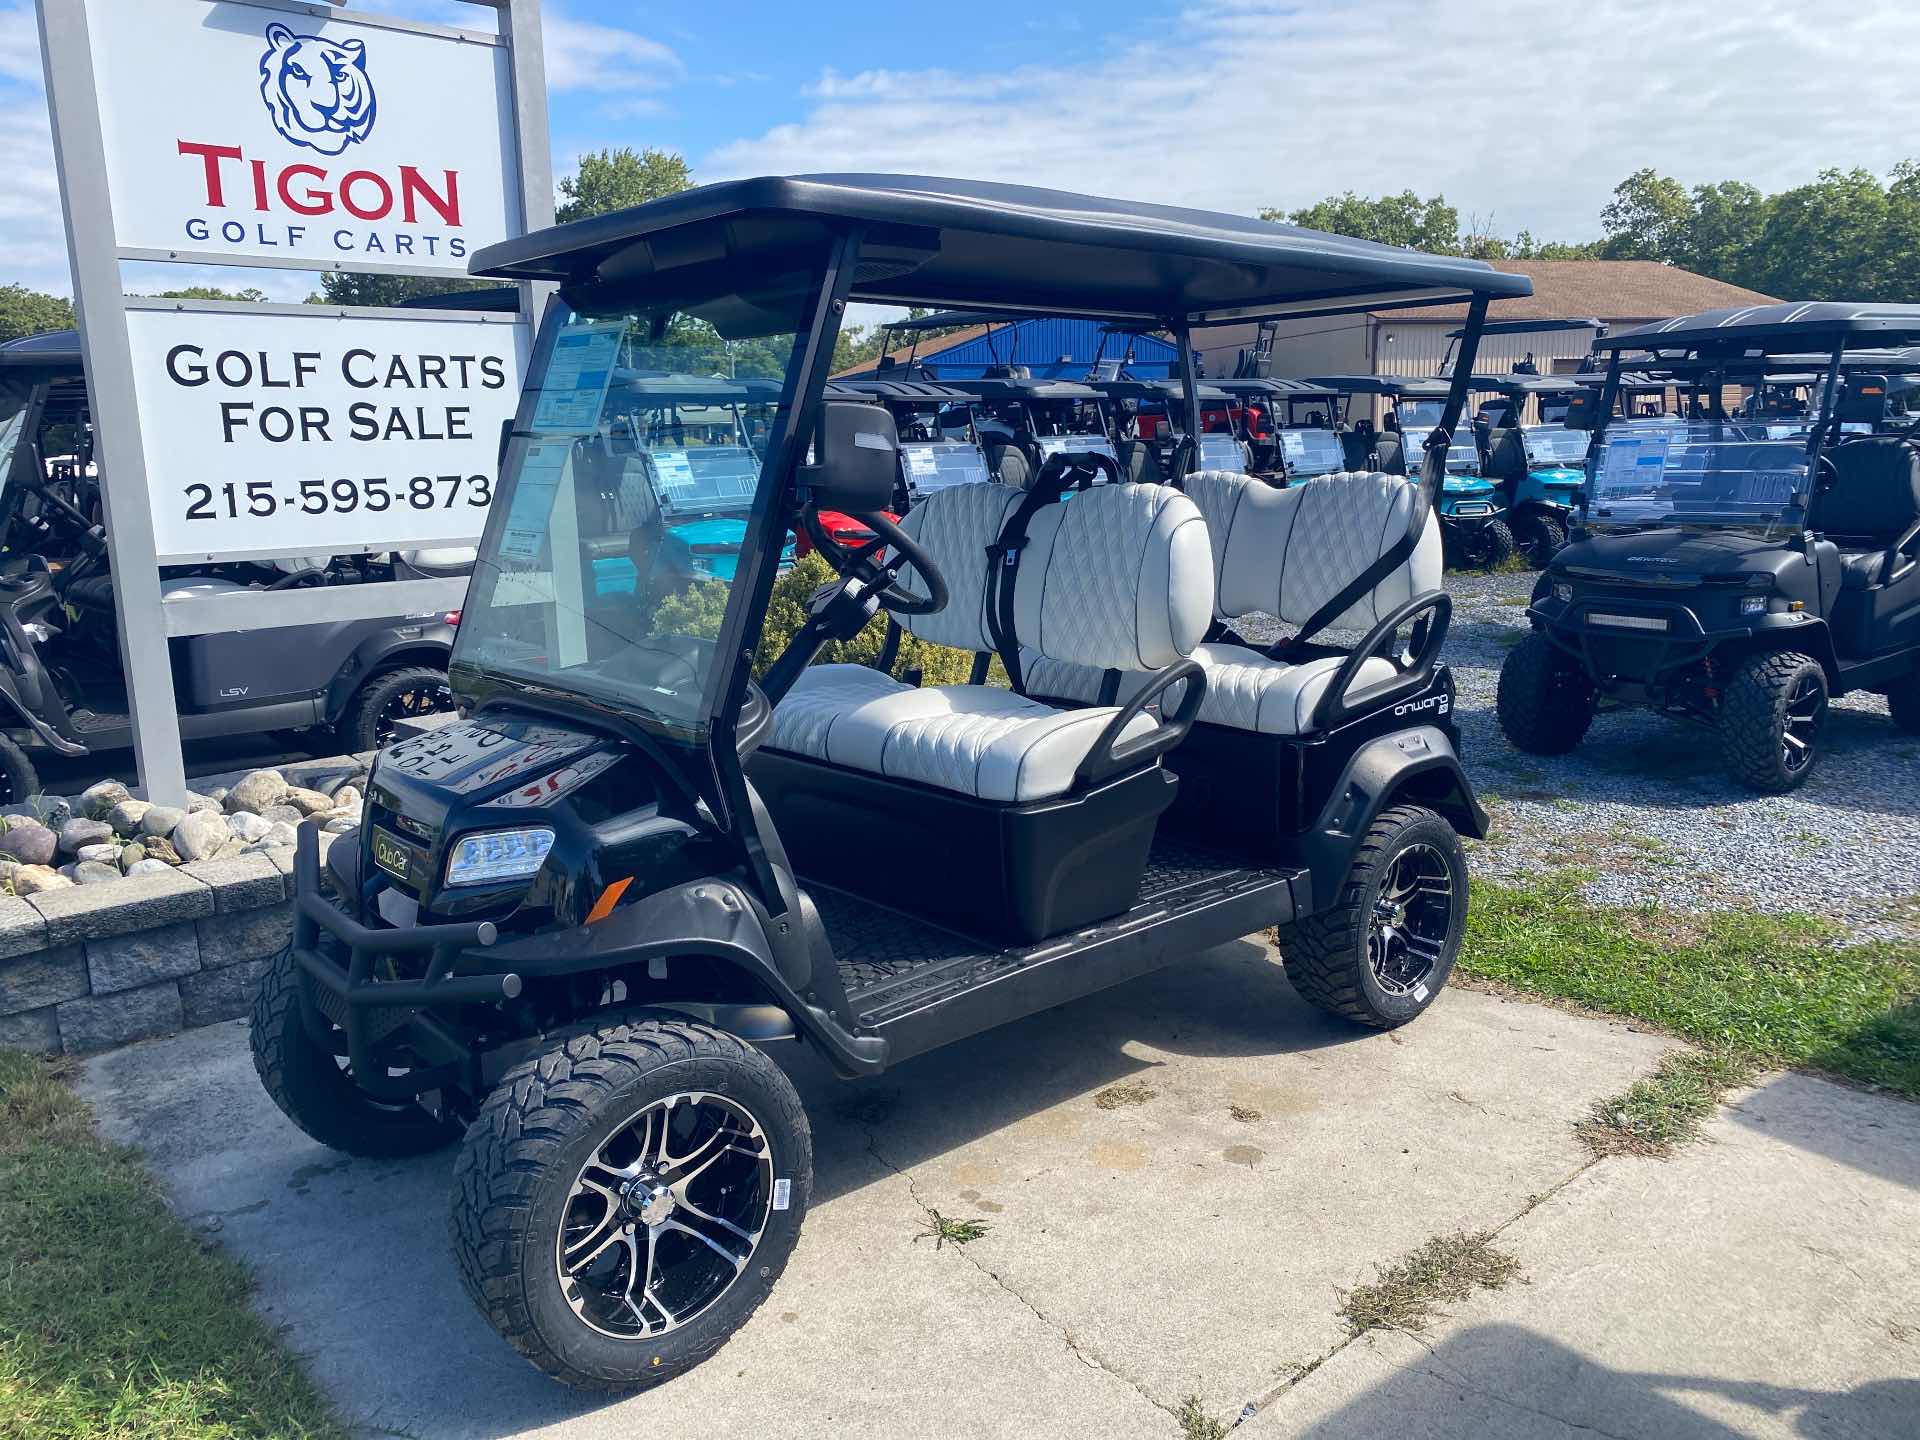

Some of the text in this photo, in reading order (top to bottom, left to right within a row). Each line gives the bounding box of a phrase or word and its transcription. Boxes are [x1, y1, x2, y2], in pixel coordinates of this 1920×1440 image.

[177, 138, 463, 227] TIGON
[186, 218, 466, 257] GOLF CARTS
[166, 344, 322, 388] GOLF
[341, 348, 505, 389] CARTS
[219, 401, 473, 442] FOR SALE
[184, 474, 492, 520] 215-595-873
[220, 686, 249, 697] LSV
